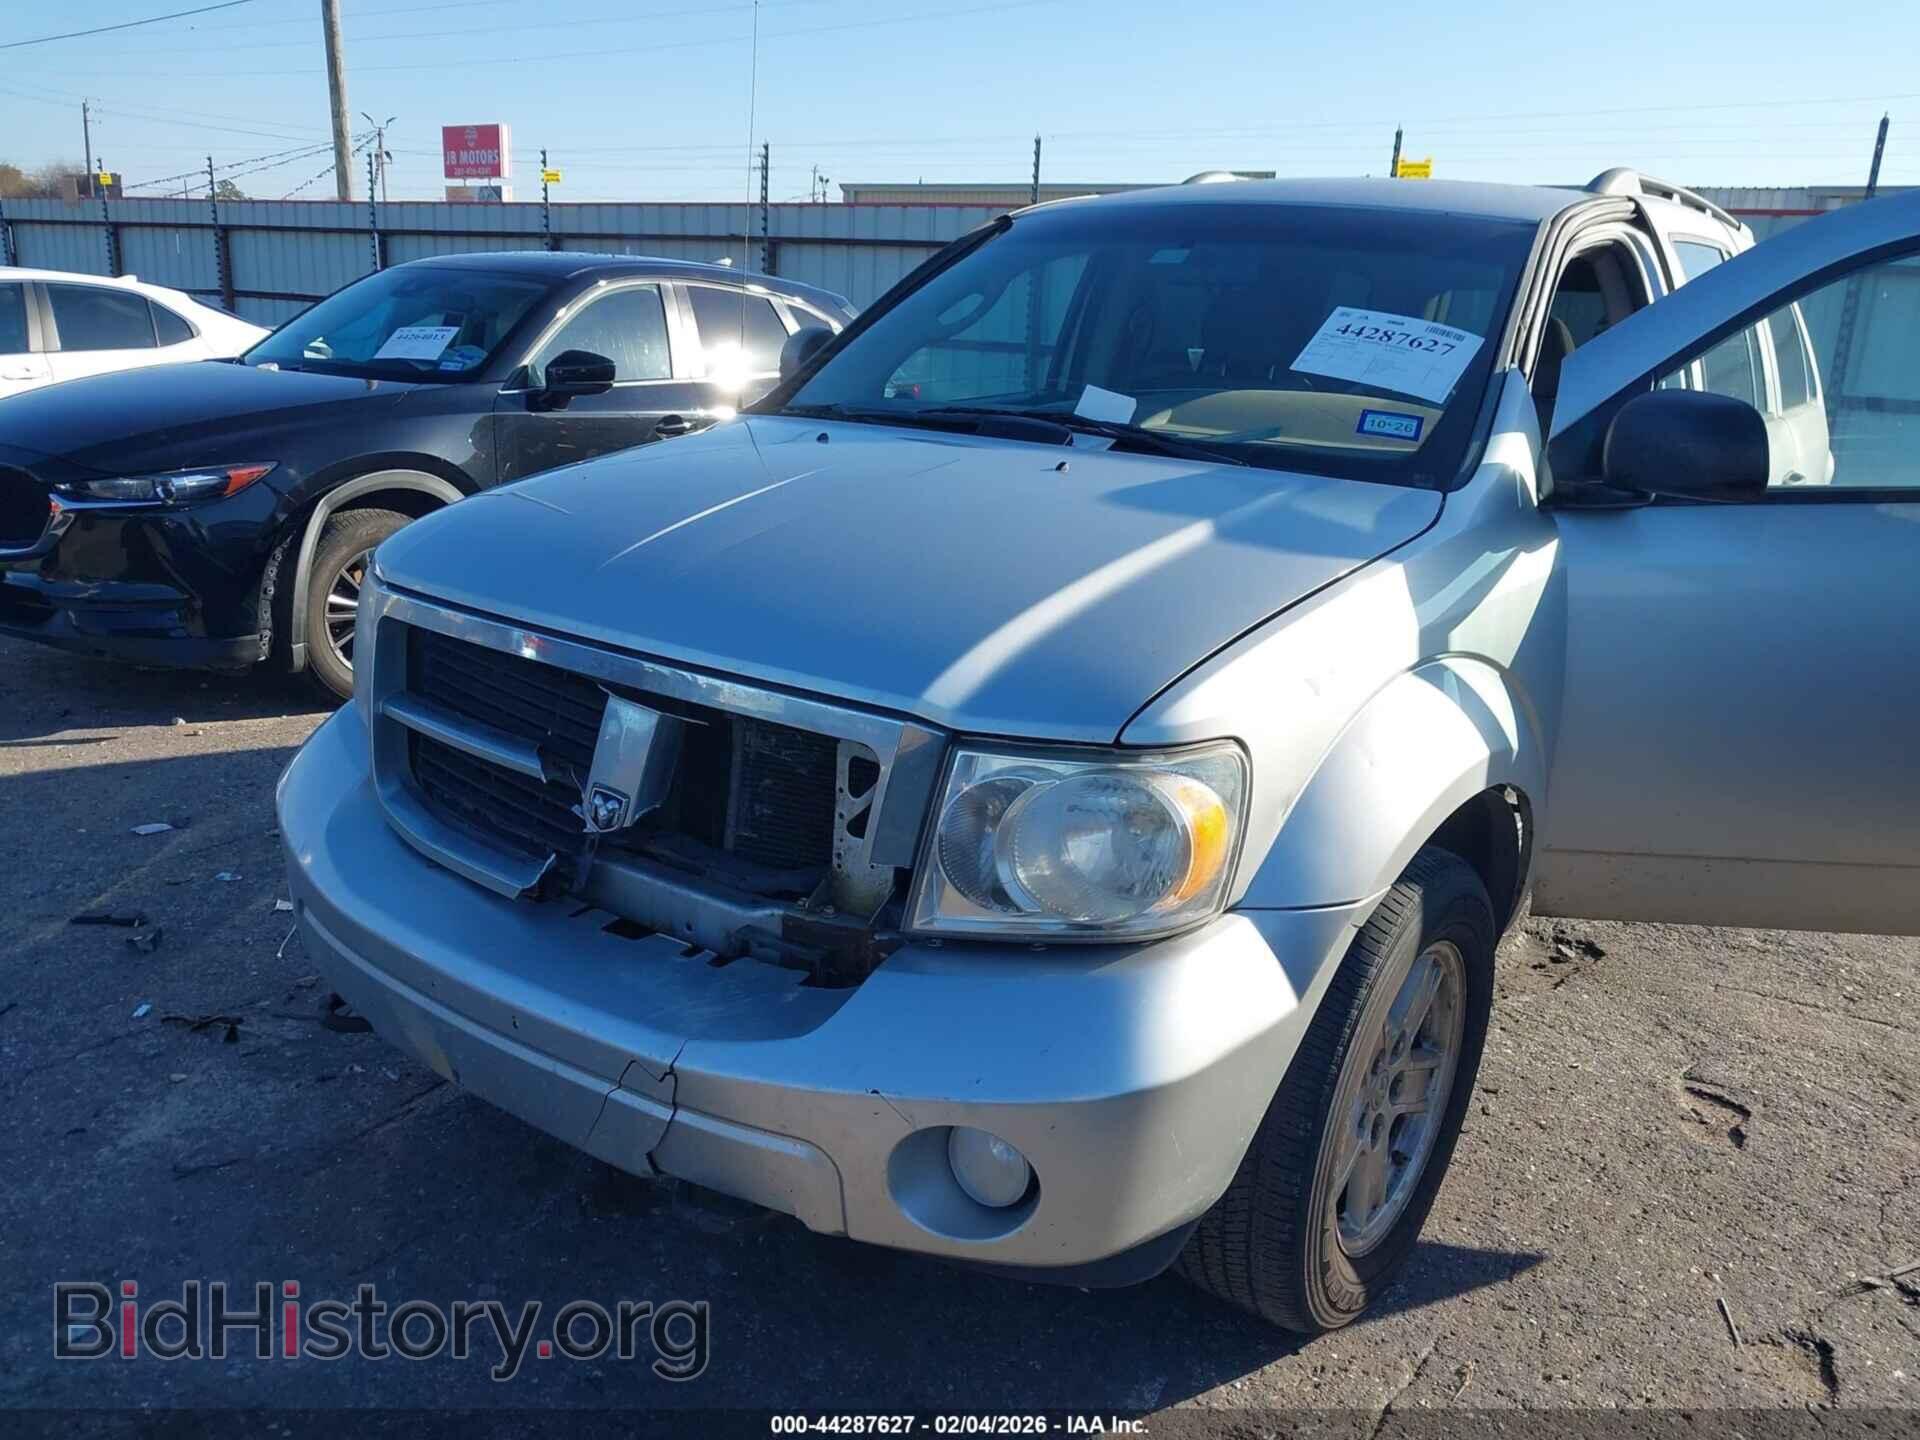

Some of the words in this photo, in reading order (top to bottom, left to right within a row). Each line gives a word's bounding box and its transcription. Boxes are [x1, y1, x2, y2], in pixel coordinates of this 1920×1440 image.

[447, 150, 457, 165] JB
[459, 149, 499, 165] MOTORS
[1336, 322, 1457, 357] 44287627
